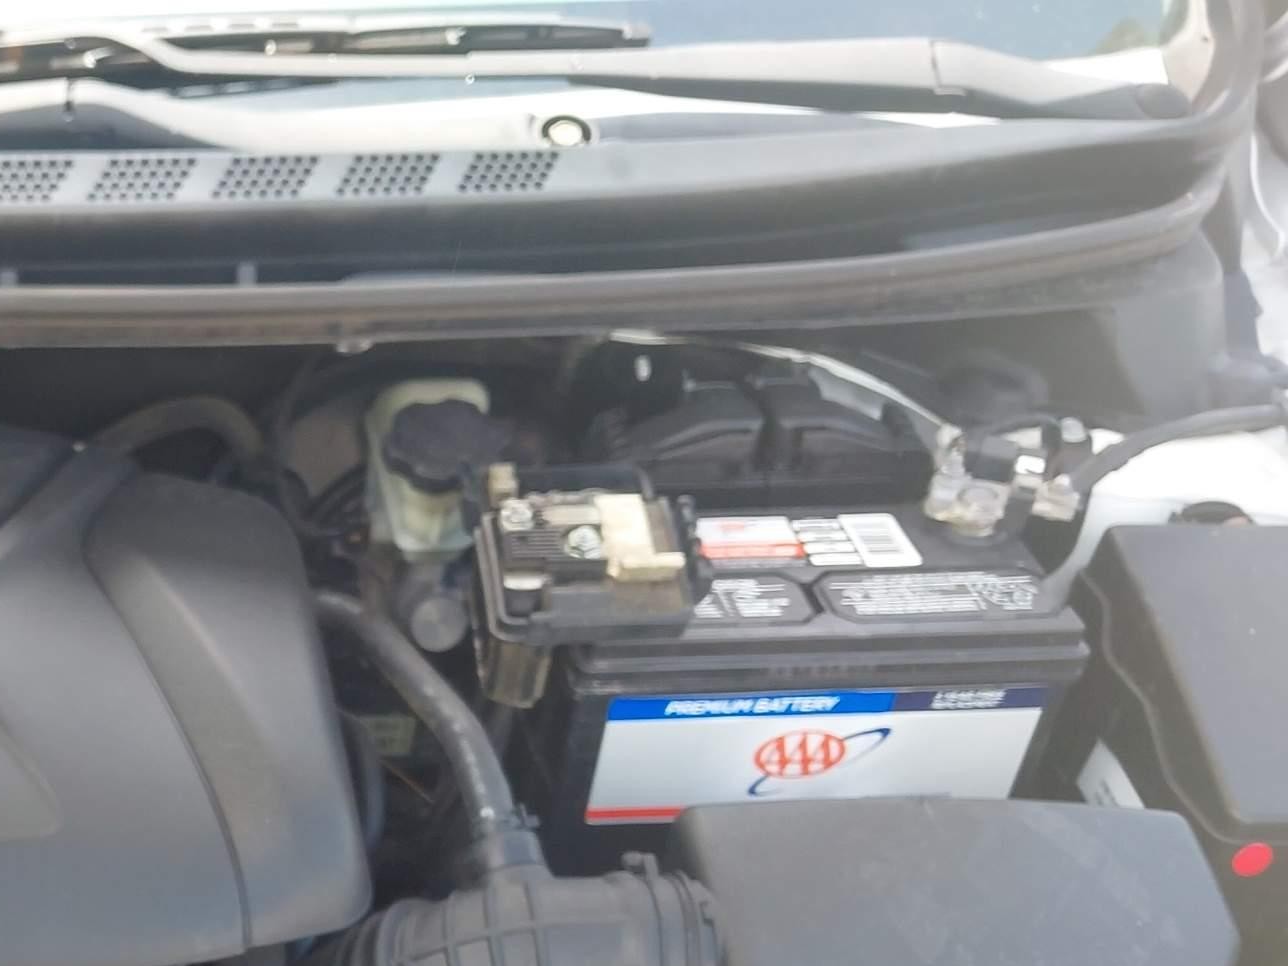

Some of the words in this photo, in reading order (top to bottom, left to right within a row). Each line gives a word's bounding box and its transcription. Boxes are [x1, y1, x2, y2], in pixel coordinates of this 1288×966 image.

[664, 698, 754, 716] PREMIUM
[752, 695, 841, 714] BATTERY
[759, 732, 839, 777] AAA
